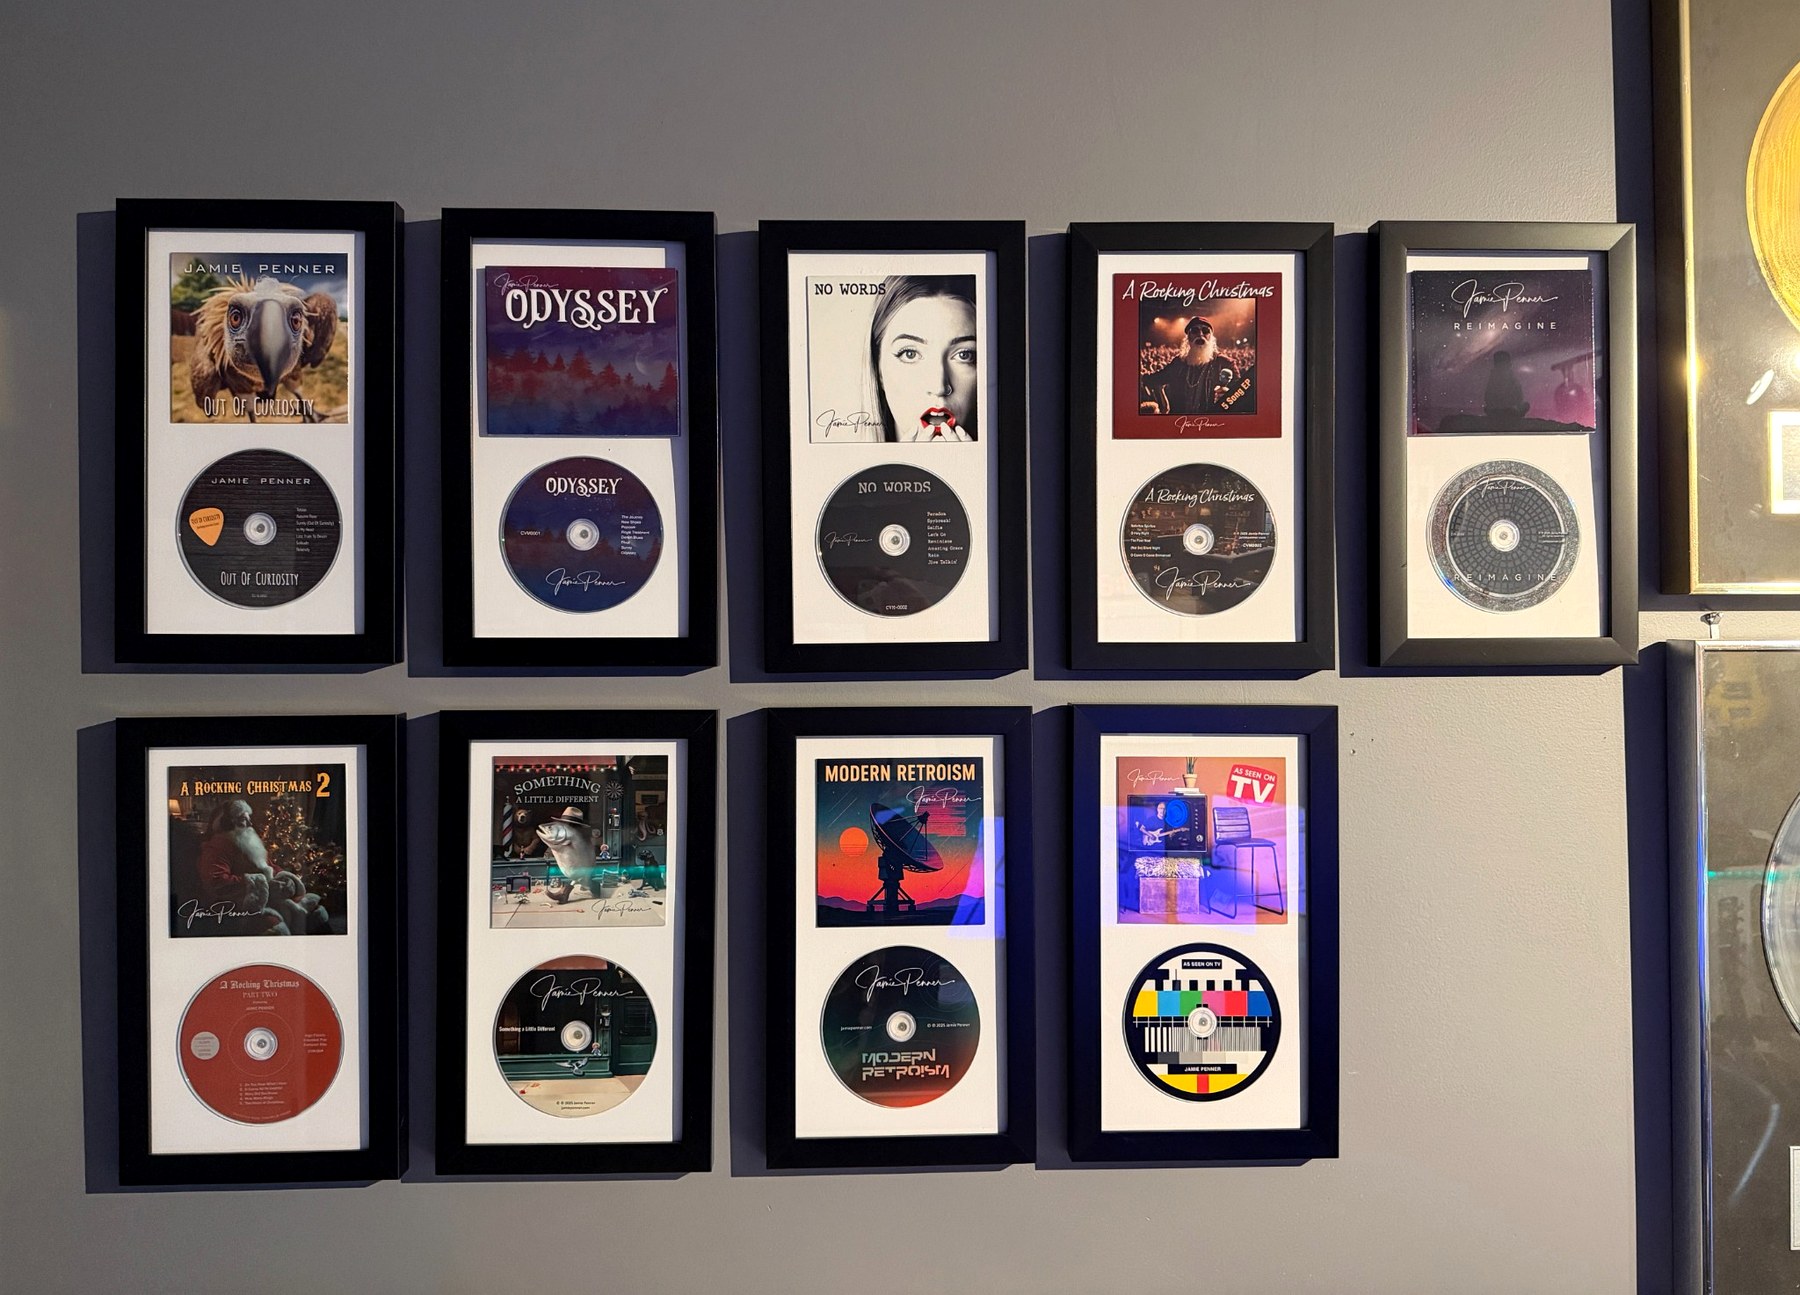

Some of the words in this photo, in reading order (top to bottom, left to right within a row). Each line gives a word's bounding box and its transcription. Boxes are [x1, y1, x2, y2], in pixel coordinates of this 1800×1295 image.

[184, 264, 241, 274] JAMIE
[259, 264, 335, 274] PENNER
[494, 272, 527, 296] Jamie
[520, 274, 559, 291] Penner
[814, 284, 833, 295] NO
[840, 284, 886, 295] WORDS
[1122, 279, 1134, 300] A
[1140, 280, 1196, 306] Rocking
[1198, 279, 1274, 301] Christmas
[505, 287, 669, 331] ODYSSEY
[1450, 279, 1496, 318] Jamie
[1492, 282, 1558, 312] Penner
[1221, 402, 1229, 410] 5
[1226, 388, 1245, 405] Song
[1240, 378, 1251, 390] EP
[816, 409, 848, 438] Jamie
[211, 477, 249, 485] JAMIE
[260, 477, 311, 485] PENNER
[545, 477, 623, 498] ODYSSEY
[858, 482, 877, 494] NO
[884, 481, 931, 493] WORDS
[1144, 488, 1154, 502] A
[1157, 488, 1198, 507] Rocking
[1199, 488, 1255, 504] Christmas
[545, 568, 581, 596] Jamie
[577, 570, 626, 592] Penner
[1155, 566, 1194, 600] Jamie
[1192, 570, 1251, 596] Penner
[180, 782, 189, 796] A
[195, 782, 242, 796] ROCKING
[247, 780, 312, 795] CHRISTMAS
[316, 772, 330, 798] 2
[514, 776, 600, 795] SOMETHING
[825, 765, 891, 782] MODERN
[897, 764, 975, 781] RETROISM
[1244, 770, 1261, 779] SEEN
[1264, 774, 1276, 782] ON
[524, 796, 554, 804] LITTLE
[555, 795, 599, 803] DIFFERENT
[906, 786, 938, 812] Jamie
[936, 787, 981, 808] Penner
[1230, 775, 1274, 804] TV
[178, 899, 214, 930] Jamie
[210, 901, 262, 924] Penner
[530, 974, 572, 1012] Jamie
[570, 977, 634, 1006] Penner
[855, 965, 895, 1002] Jamie
[894, 968, 955, 995] Penner
[862, 1049, 936, 1066] MODERN
